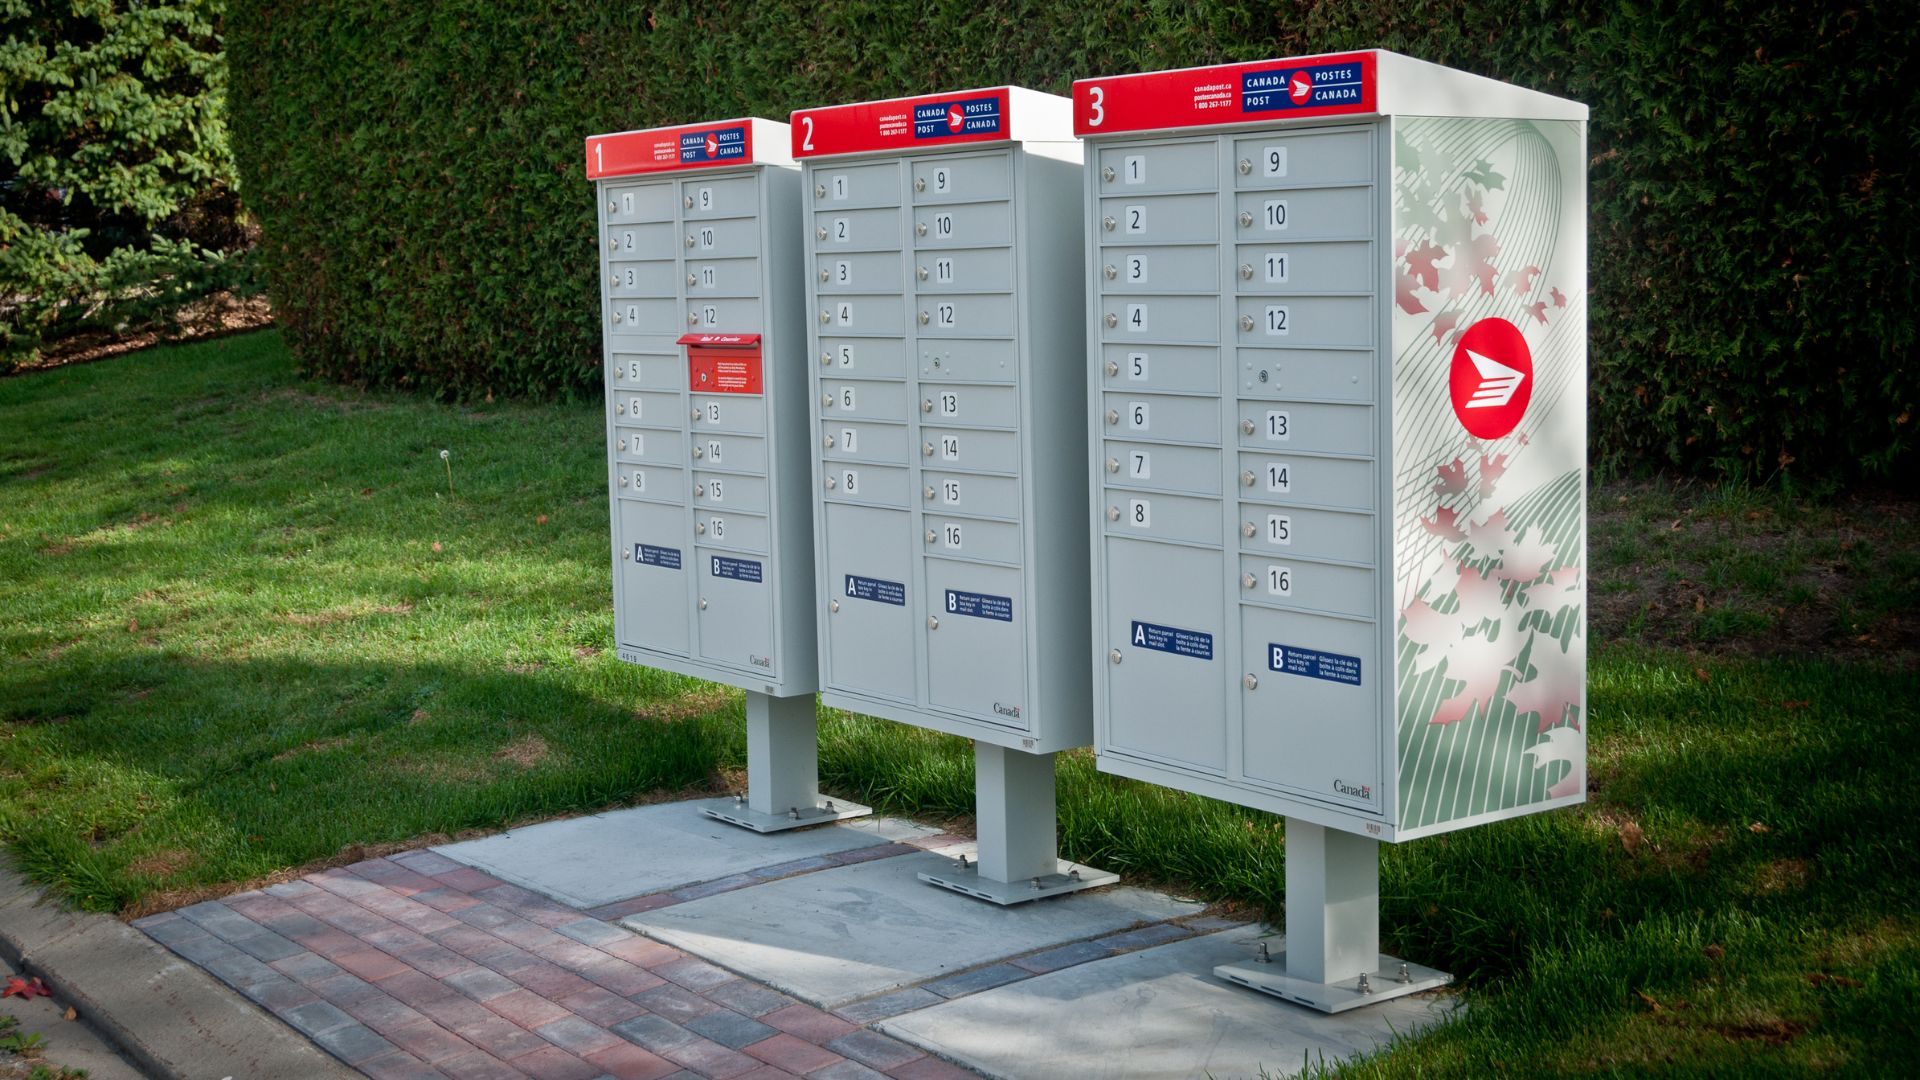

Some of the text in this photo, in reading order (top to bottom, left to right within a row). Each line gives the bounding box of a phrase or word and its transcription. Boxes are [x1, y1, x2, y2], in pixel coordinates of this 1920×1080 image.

[1247, 76, 1285, 88] CANADA
[1315, 70, 1351, 81] POSTES
[1194, 84, 1232, 92] canadapost.ca
[1315, 89, 1356, 100] CANADA
[966, 103, 992, 113] POSTES
[1088, 87, 1103, 126] 3
[1247, 96, 1270, 106] POST
[917, 108, 945, 118] CANADA
[918, 125, 934, 134] POST
[966, 120, 996, 129] CANADA
[682, 136, 704, 145] CANADA
[720, 132, 739, 141] POSTES
[802, 117, 814, 150] 2
[596, 143, 602, 172] 1
[720, 146, 742, 155] CANADA
[1131, 160, 1137, 179] 1
[1270, 152, 1279, 172] 9
[838, 180, 843, 195] 1
[938, 172, 945, 189] 9
[626, 197, 629, 210] 1
[703, 192, 708, 206] 9
[1132, 210, 1139, 229] 2
[1267, 204, 1285, 225] 10
[839, 222, 844, 238] 2
[937, 217, 950, 234] 10
[627, 234, 632, 248] 2
[702, 230, 712, 245] 10
[840, 264, 846, 280] 3
[938, 262, 950, 278] 11
[1133, 260, 1140, 278] 3
[1268, 258, 1285, 278] 11
[628, 270, 633, 285] 3
[704, 270, 713, 284] 11
[630, 308, 635, 322] 4
[705, 309, 715, 323] 12
[841, 307, 848, 322] 4
[940, 306, 953, 323] 12
[1133, 308, 1141, 327] 4
[1268, 310, 1286, 330] 12
[843, 349, 849, 364] 5
[632, 364, 637, 377] 5
[1134, 358, 1142, 376] 5
[844, 390, 850, 406] 6
[943, 396, 956, 412] 13
[633, 401, 638, 414] 6
[708, 405, 719, 420] 13
[1135, 406, 1142, 424] 6
[1269, 416, 1287, 435] 13
[634, 437, 639, 451] 7
[846, 432, 852, 448] 7
[944, 440, 957, 456] 14
[710, 444, 720, 459] 14
[1136, 456, 1143, 473] 7
[636, 474, 641, 488] 8
[847, 474, 854, 490] 8
[1269, 468, 1288, 487] 14
[711, 483, 721, 497] 15
[945, 483, 958, 500] 15
[1136, 504, 1144, 522] 8
[712, 521, 722, 536] 16
[947, 528, 960, 544] 16
[1270, 519, 1288, 539] 15
[637, 546, 644, 561] A
[714, 559, 720, 574] B
[848, 578, 856, 595] A
[1271, 570, 1288, 591] 16
[949, 593, 956, 610] B
[1135, 625, 1145, 645] A
[1274, 647, 1283, 668] B
[994, 702, 1020, 718] Canada
[1334, 780, 1370, 800] Canada
